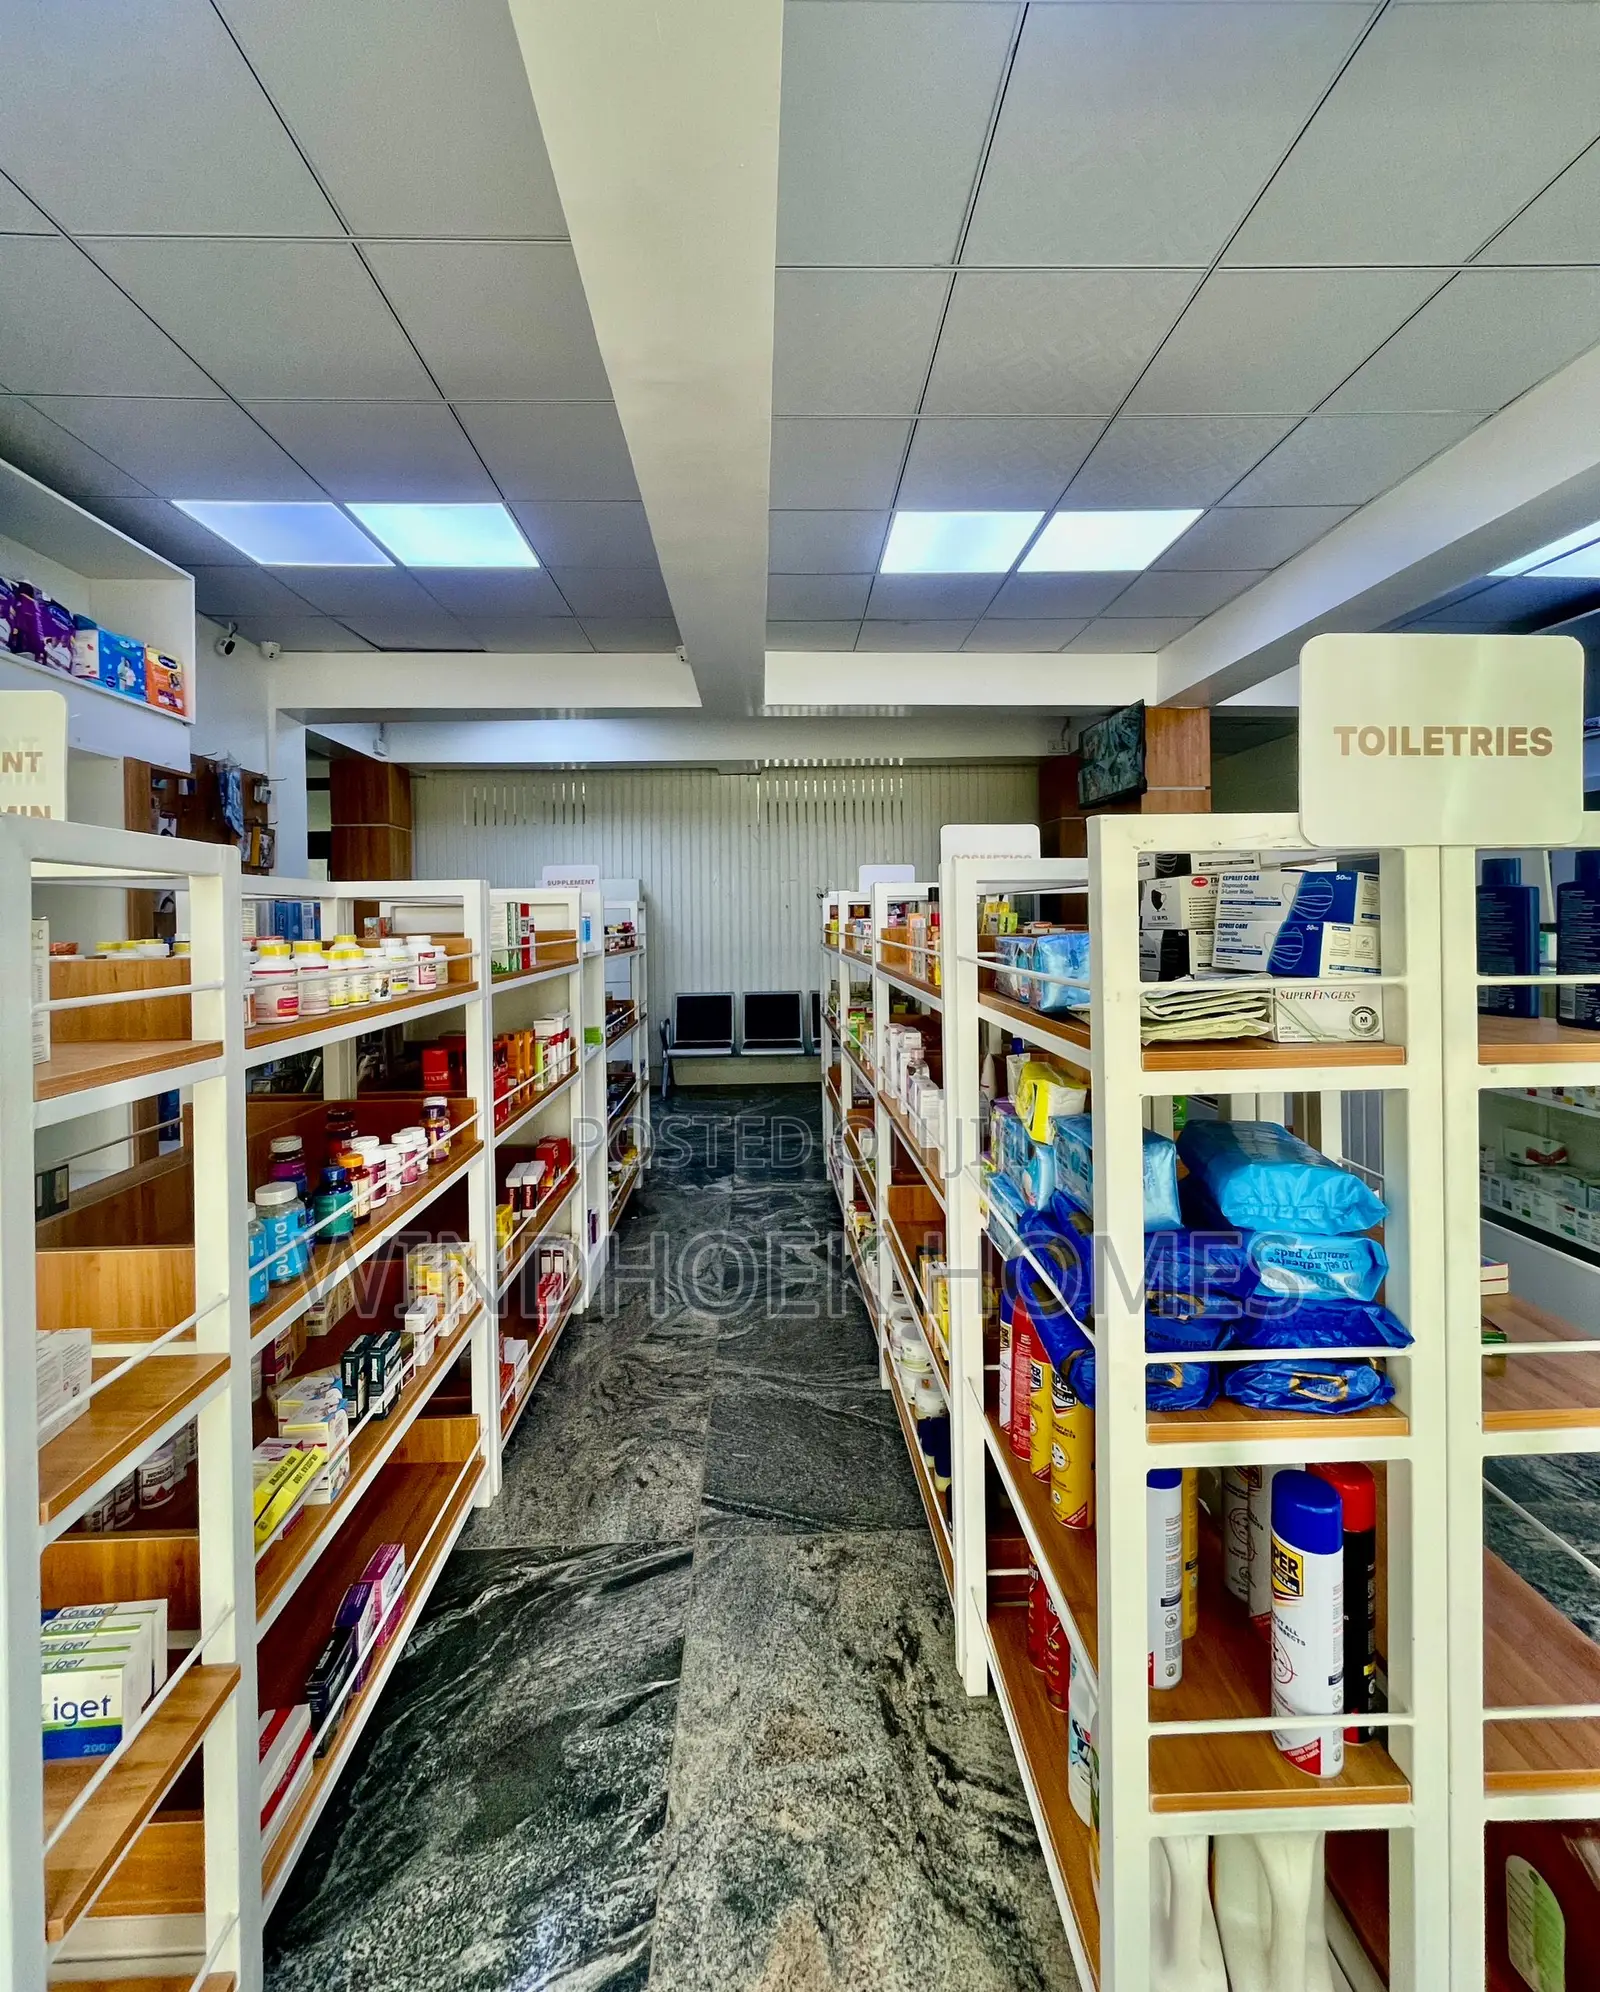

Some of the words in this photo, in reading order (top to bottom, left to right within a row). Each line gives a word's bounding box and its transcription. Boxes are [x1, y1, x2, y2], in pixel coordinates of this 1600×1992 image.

[1333, 726, 1553, 757] TOILETRIES
[547, 879, 596, 887] SUPPLEMENT
[1273, 1247, 1303, 1260] pads
[1306, 1249, 1350, 1262] sanitary
[1267, 1256, 1322, 1270] adhesive
[1323, 1260, 1341, 1273] self
[1341, 1260, 1354, 1271] 10
[1273, 1543, 1299, 1579] PER
